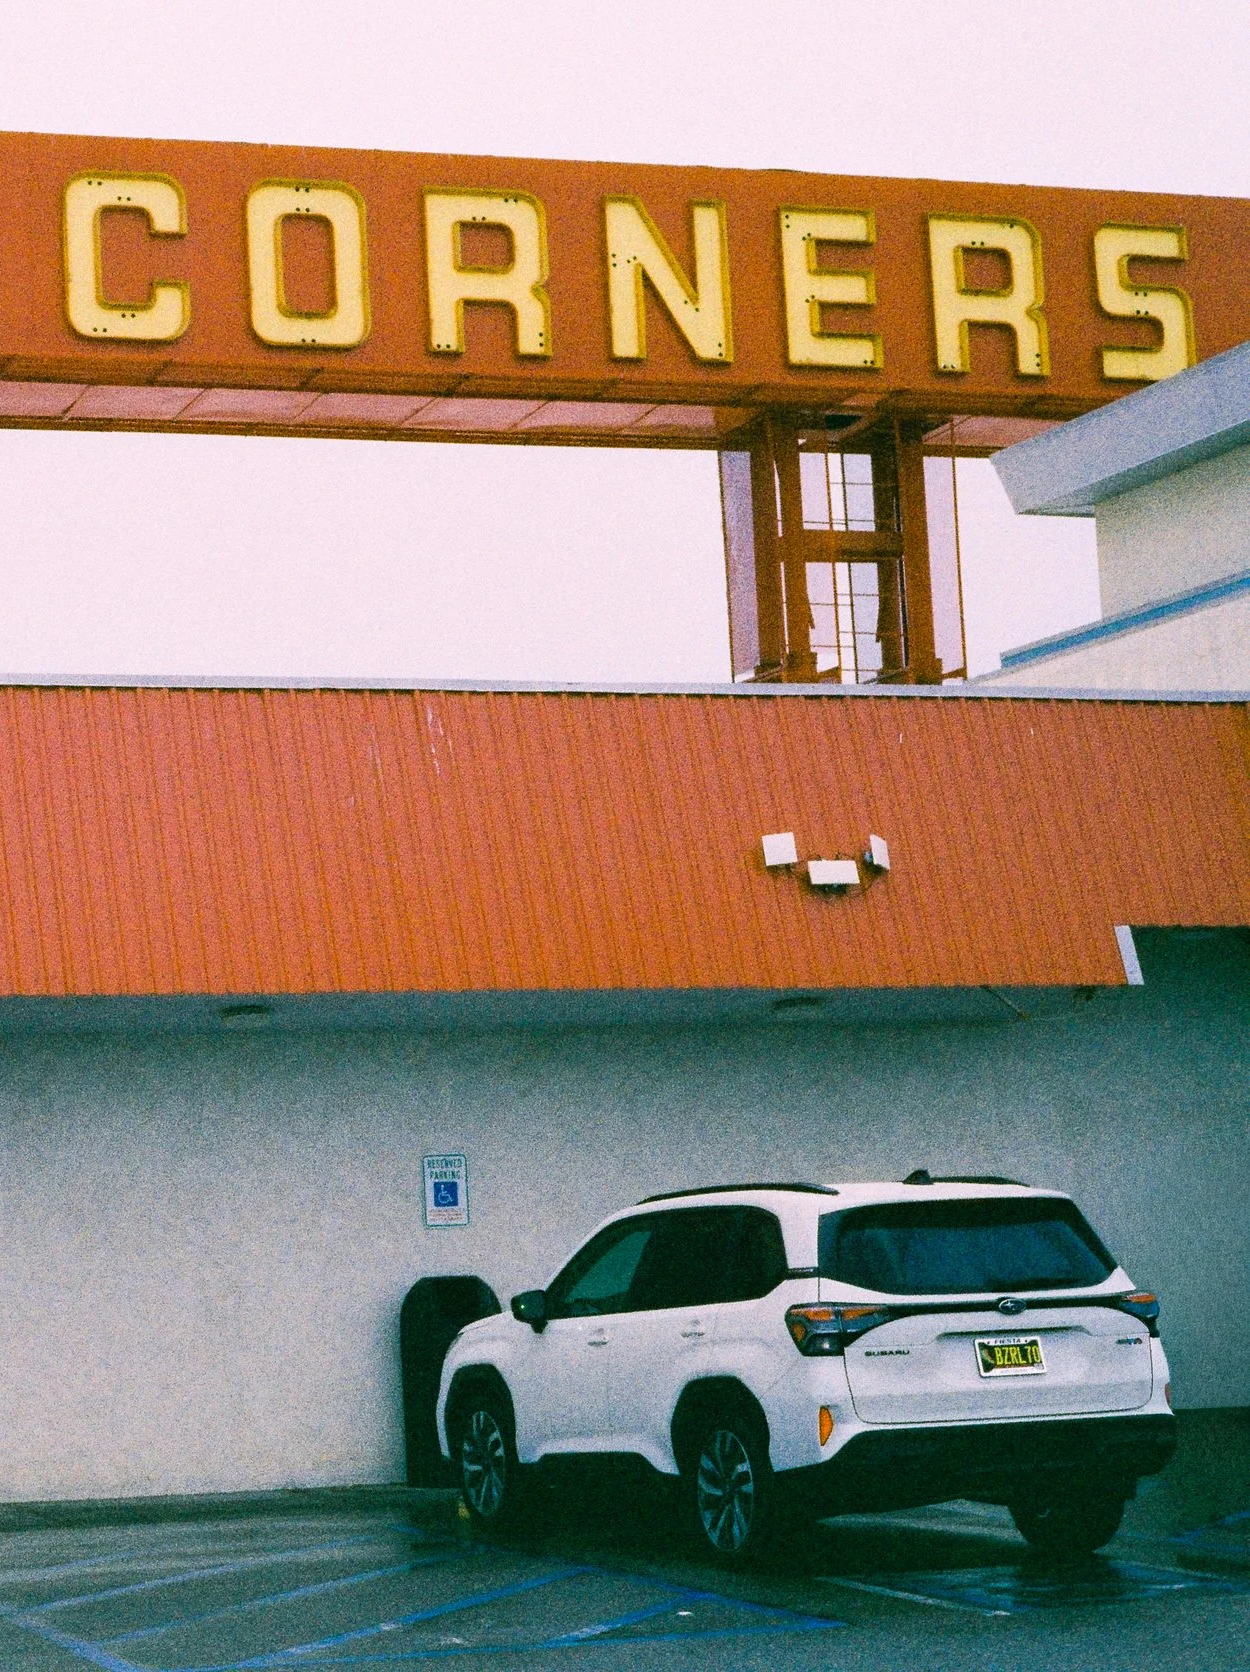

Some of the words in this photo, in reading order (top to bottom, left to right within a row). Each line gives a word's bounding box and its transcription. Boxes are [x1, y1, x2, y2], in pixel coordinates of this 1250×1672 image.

[63, 169, 1196, 381] CORNERS
[427, 1159, 463, 1169] RESERVED
[430, 1170, 461, 1180] PARKING
[864, 1349, 910, 1357] SUBARU
